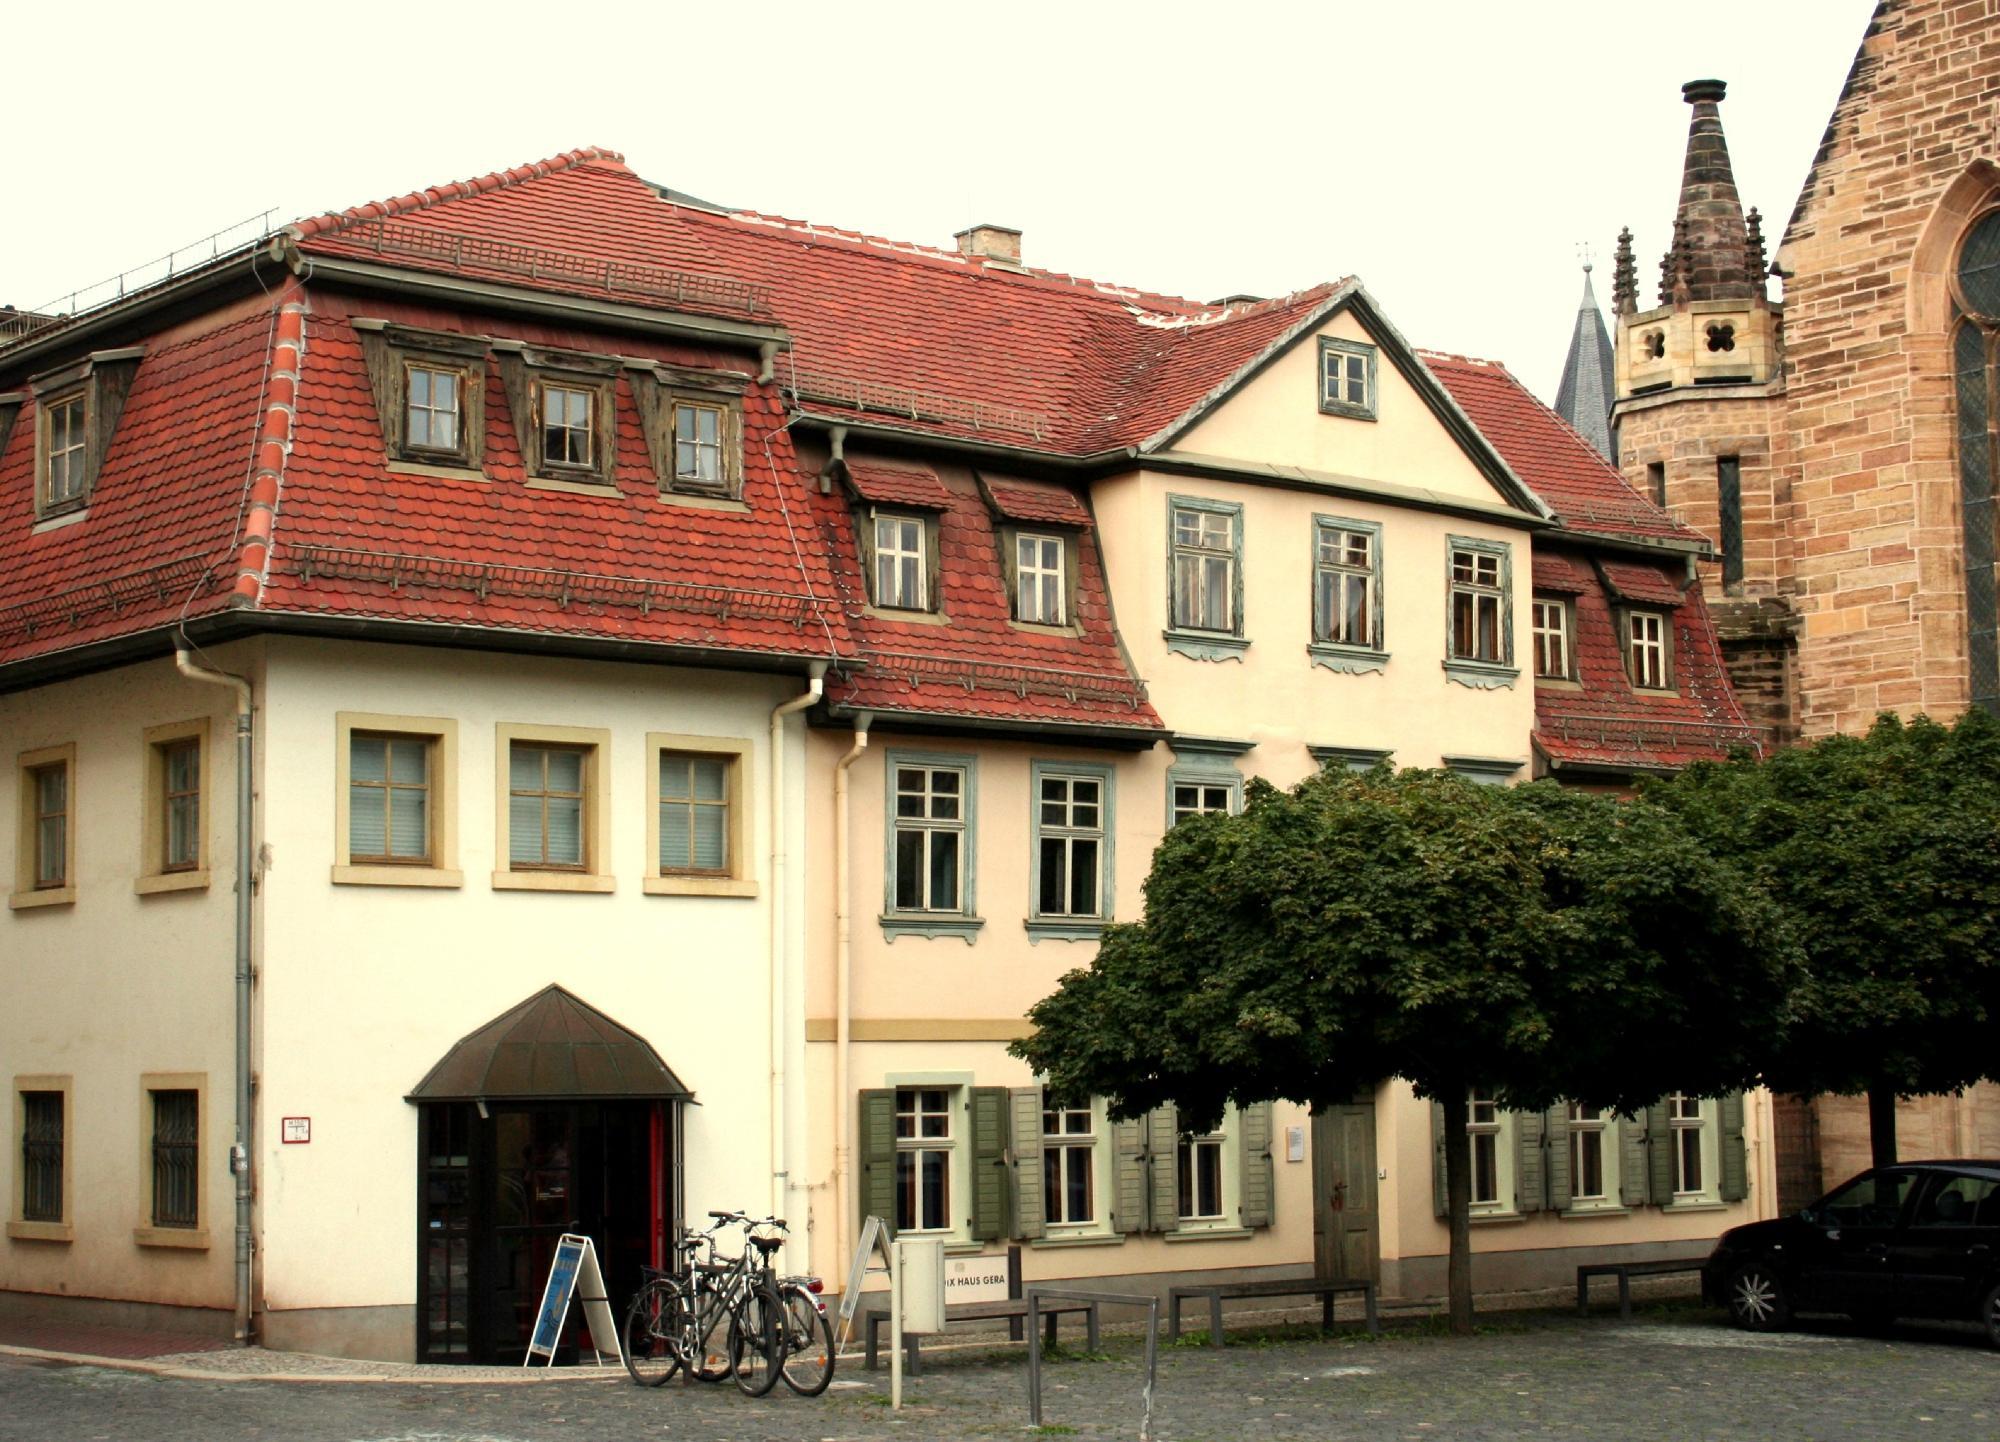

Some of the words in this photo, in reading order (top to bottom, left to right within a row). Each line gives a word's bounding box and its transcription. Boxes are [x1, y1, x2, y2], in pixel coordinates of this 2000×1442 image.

[944, 1278, 955, 1287] IX
[958, 1276, 981, 1286] HAUS
[983, 1275, 1005, 1284] GERA
